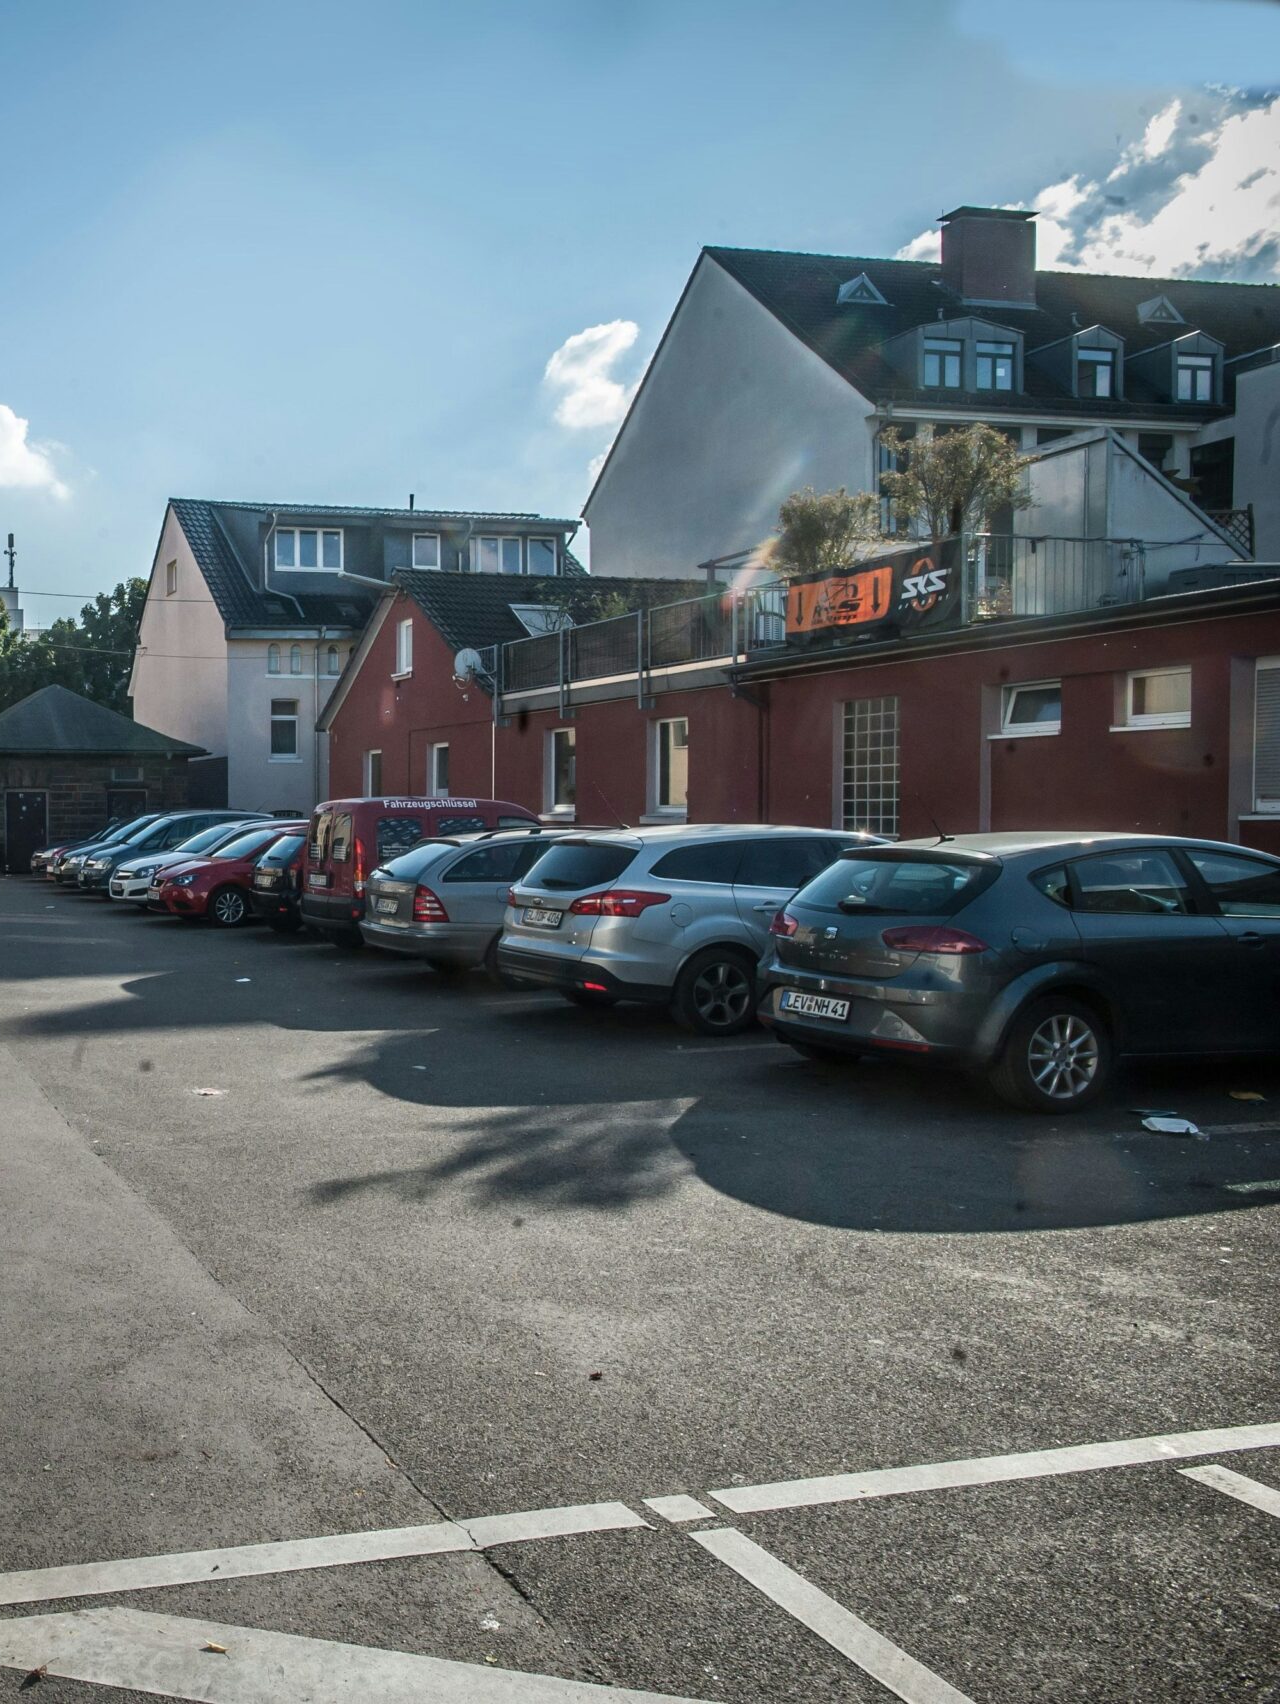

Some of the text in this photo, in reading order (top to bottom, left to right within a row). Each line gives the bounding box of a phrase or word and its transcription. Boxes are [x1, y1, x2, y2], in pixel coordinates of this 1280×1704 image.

[900, 568, 947, 600] SKS
[383, 799, 477, 810] Fahrzeugschlüssel
[831, 1001, 846, 1017] 41
